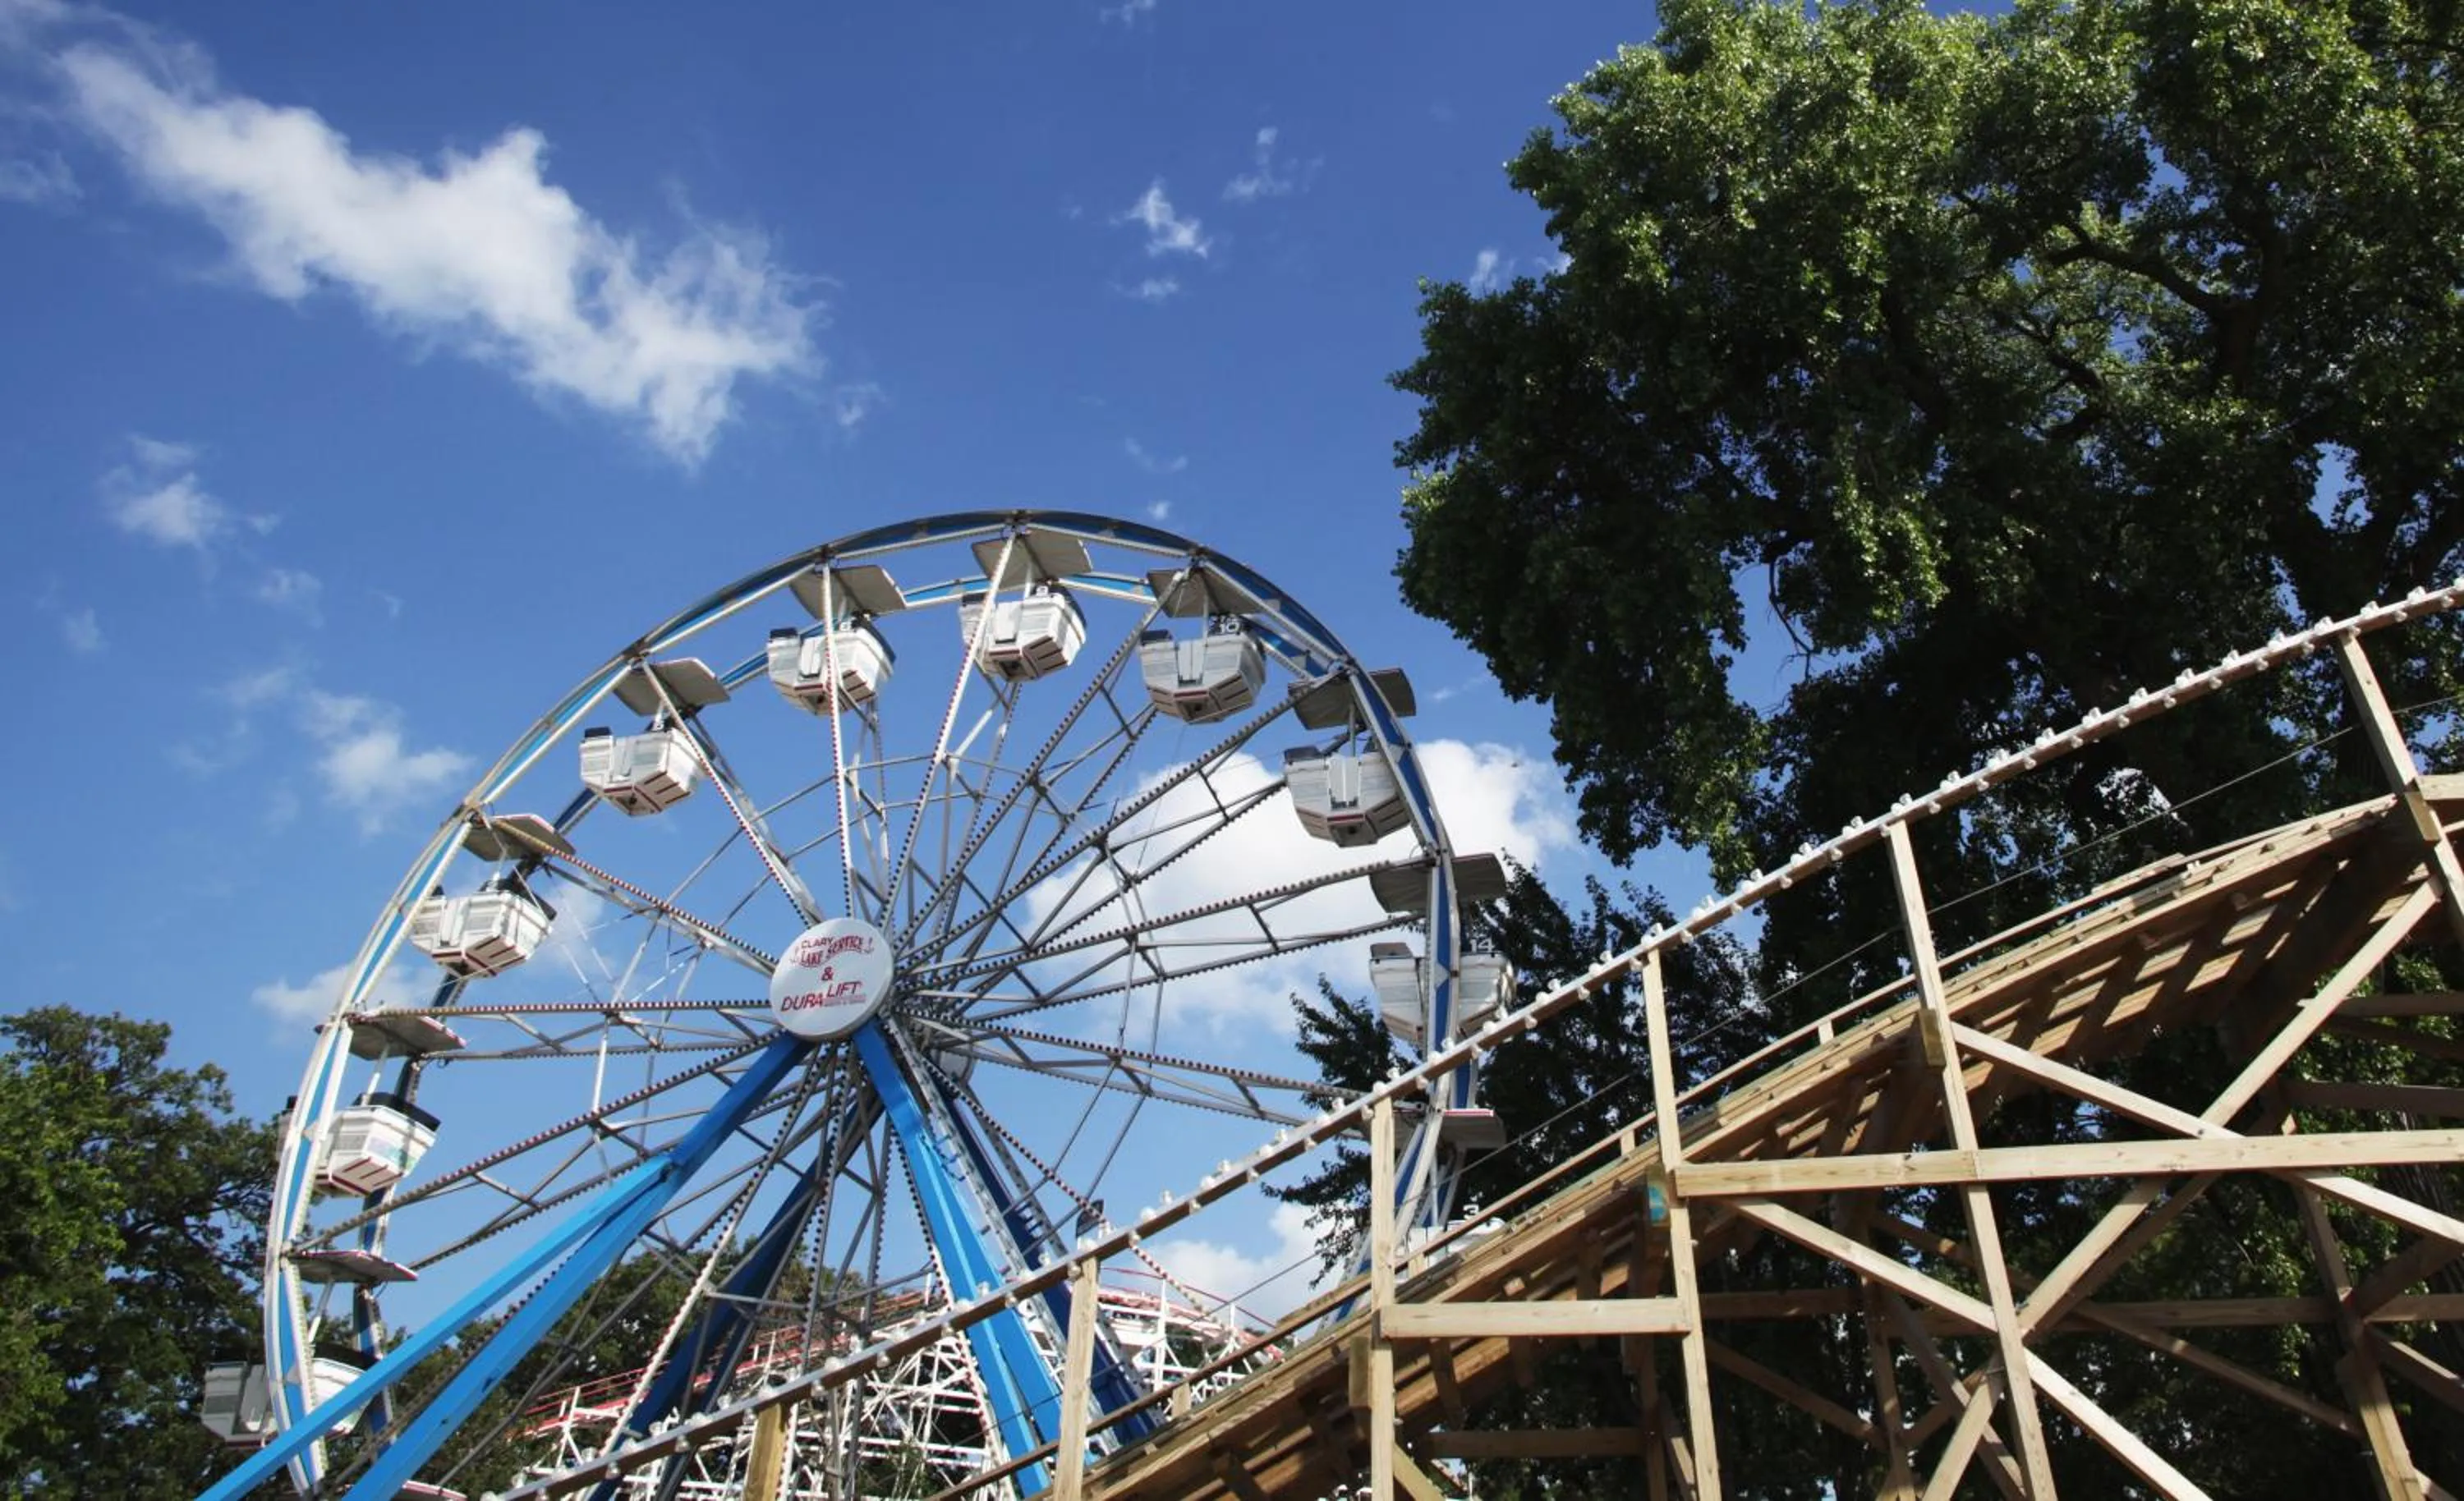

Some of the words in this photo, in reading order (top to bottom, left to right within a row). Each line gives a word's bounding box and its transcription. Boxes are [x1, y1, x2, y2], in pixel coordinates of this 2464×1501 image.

[1470, 937, 1496, 953] 14
[821, 966, 834, 981] &
[780, 993, 823, 1012] DURA
[827, 981, 862, 998] LIFT
[1463, 1204, 1479, 1220] 3
